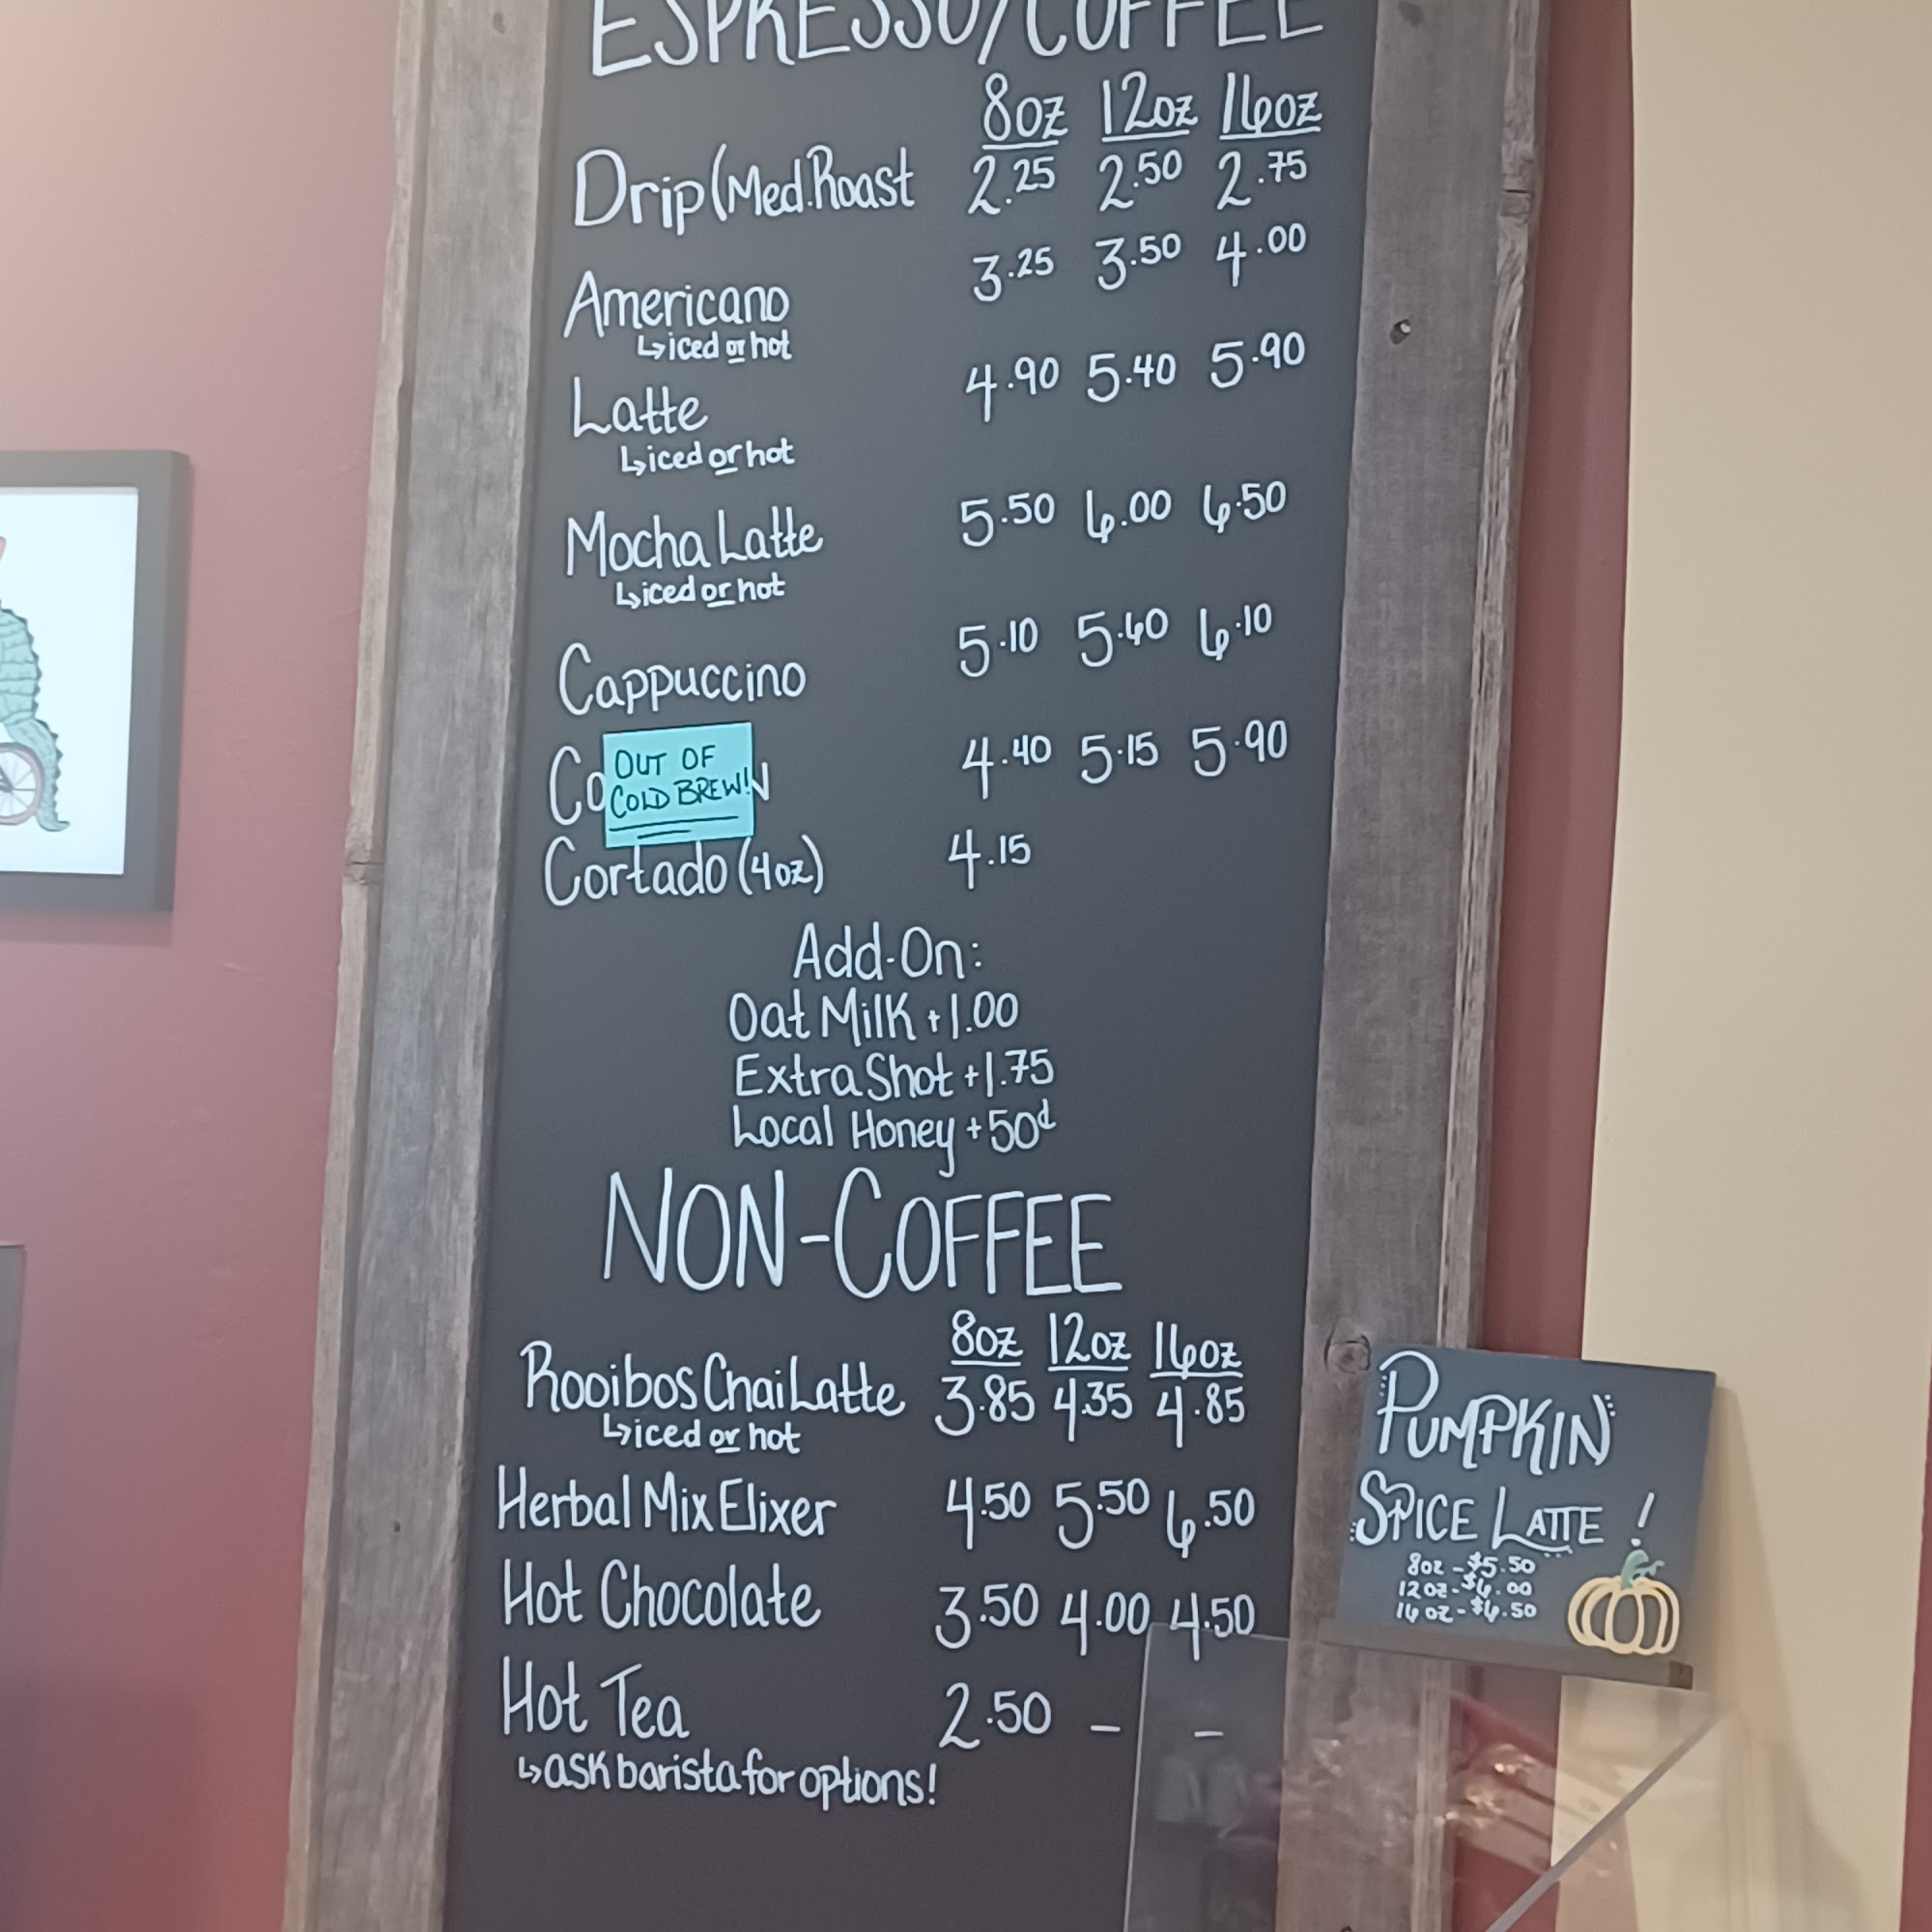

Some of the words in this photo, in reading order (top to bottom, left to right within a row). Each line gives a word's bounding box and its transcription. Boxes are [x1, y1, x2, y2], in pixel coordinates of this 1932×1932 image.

[983, 72, 1069, 142] 8oz
[1102, 71, 1199, 137] 12oz
[574, 149, 705, 236] Drip
[967, 155, 1056, 215] 2.25
[1099, 149, 1182, 213] 2.50
[1216, 149, 1307, 211] 2.75
[563, 270, 790, 339] Americano
[973, 246, 1054, 302] 3.25
[1094, 233, 1181, 291] 3.50
[1216, 222, 1307, 288] 4.00
[668, 330, 720, 361] iced
[725, 339, 746, 356] or
[750, 328, 793, 360] hot
[573, 376, 709, 438] Latte
[965, 356, 1060, 423] 4.90
[1087, 353, 1177, 403] 5.40
[1210, 331, 1305, 389] 5.90
[646, 440, 703, 473] iced
[708, 443, 743, 470] or
[745, 437, 796, 468] hot
[566, 510, 712, 579] Mocha
[718, 505, 824, 565] Latte
[960, 492, 1055, 548] 5.50
[1086, 489, 1172, 544] 6.00
[1203, 480, 1287, 534] 6.50
[641, 574, 696, 607] iced
[700, 582, 733, 603] or
[736, 571, 786, 603] hot
[559, 642, 807, 716] Cappuccino
[958, 616, 1038, 678] 5.10
[1200, 603, 1272, 662] 6.10
[611, 784, 670, 819] COLD
[673, 766, 752, 806] BREW!
[615, 750, 667, 779] OUT
[682, 744, 716, 770] OF
[961, 734, 1052, 800] 4.40
[1081, 730, 1159, 784] 5.15
[1192, 719, 1288, 777] 5.90
[544, 835, 729, 906] Cortado
[737, 833, 824, 895] (4oz)
[948, 828, 1032, 890] 4.15
[729, 987, 811, 1042] Oat
[736, 1052, 864, 1097] Extra
[866, 1051, 954, 1102] Shot
[732, 1103, 834, 1149] Local
[849, 1108, 955, 1179] Honey
[603, 1164, 1123, 1299] NON-COFFEE
[952, 1309, 1024, 1359] 8oz
[1049, 1312, 1132, 1365] 12oz
[519, 1340, 698, 1414] Rooibos
[789, 1354, 906, 1417] Latte
[934, 1373, 1036, 1436] 3.85
[1053, 1377, 1133, 1442] 4.35
[1155, 1382, 1245, 1449] 4.85
[1377, 1350, 1610, 1475] PUMPKIN
[634, 1418, 701, 1449] iced
[708, 1427, 741, 1449] or
[748, 1421, 802, 1455] hot
[497, 1463, 631, 1530] Herbal
[643, 1470, 714, 1533] Mix
[719, 1477, 838, 1538] Elixer
[946, 1476, 1032, 1550] 4.50
[1056, 1477, 1151, 1549] 5.50
[1166, 1487, 1255, 1559] 6.50
[1356, 1469, 1478, 1546] SPICE
[1492, 1486, 1605, 1556] LATTE
[1406, 1551, 1444, 1577] 8oz
[503, 1557, 583, 1627] Hot
[600, 1558, 822, 1630] Chocolate
[934, 1582, 1039, 1650] 3.50
[1060, 1588, 1152, 1660] 4.00
[1169, 1592, 1255, 1662] 4.50
[502, 1655, 588, 1736] Hot
[600, 1662, 691, 1739] Tea
[938, 1682, 1052, 1749] 2.50
[616, 1747, 742, 1793] barista
[741, 1747, 796, 1796] for
[799, 1754, 937, 1811] options!
